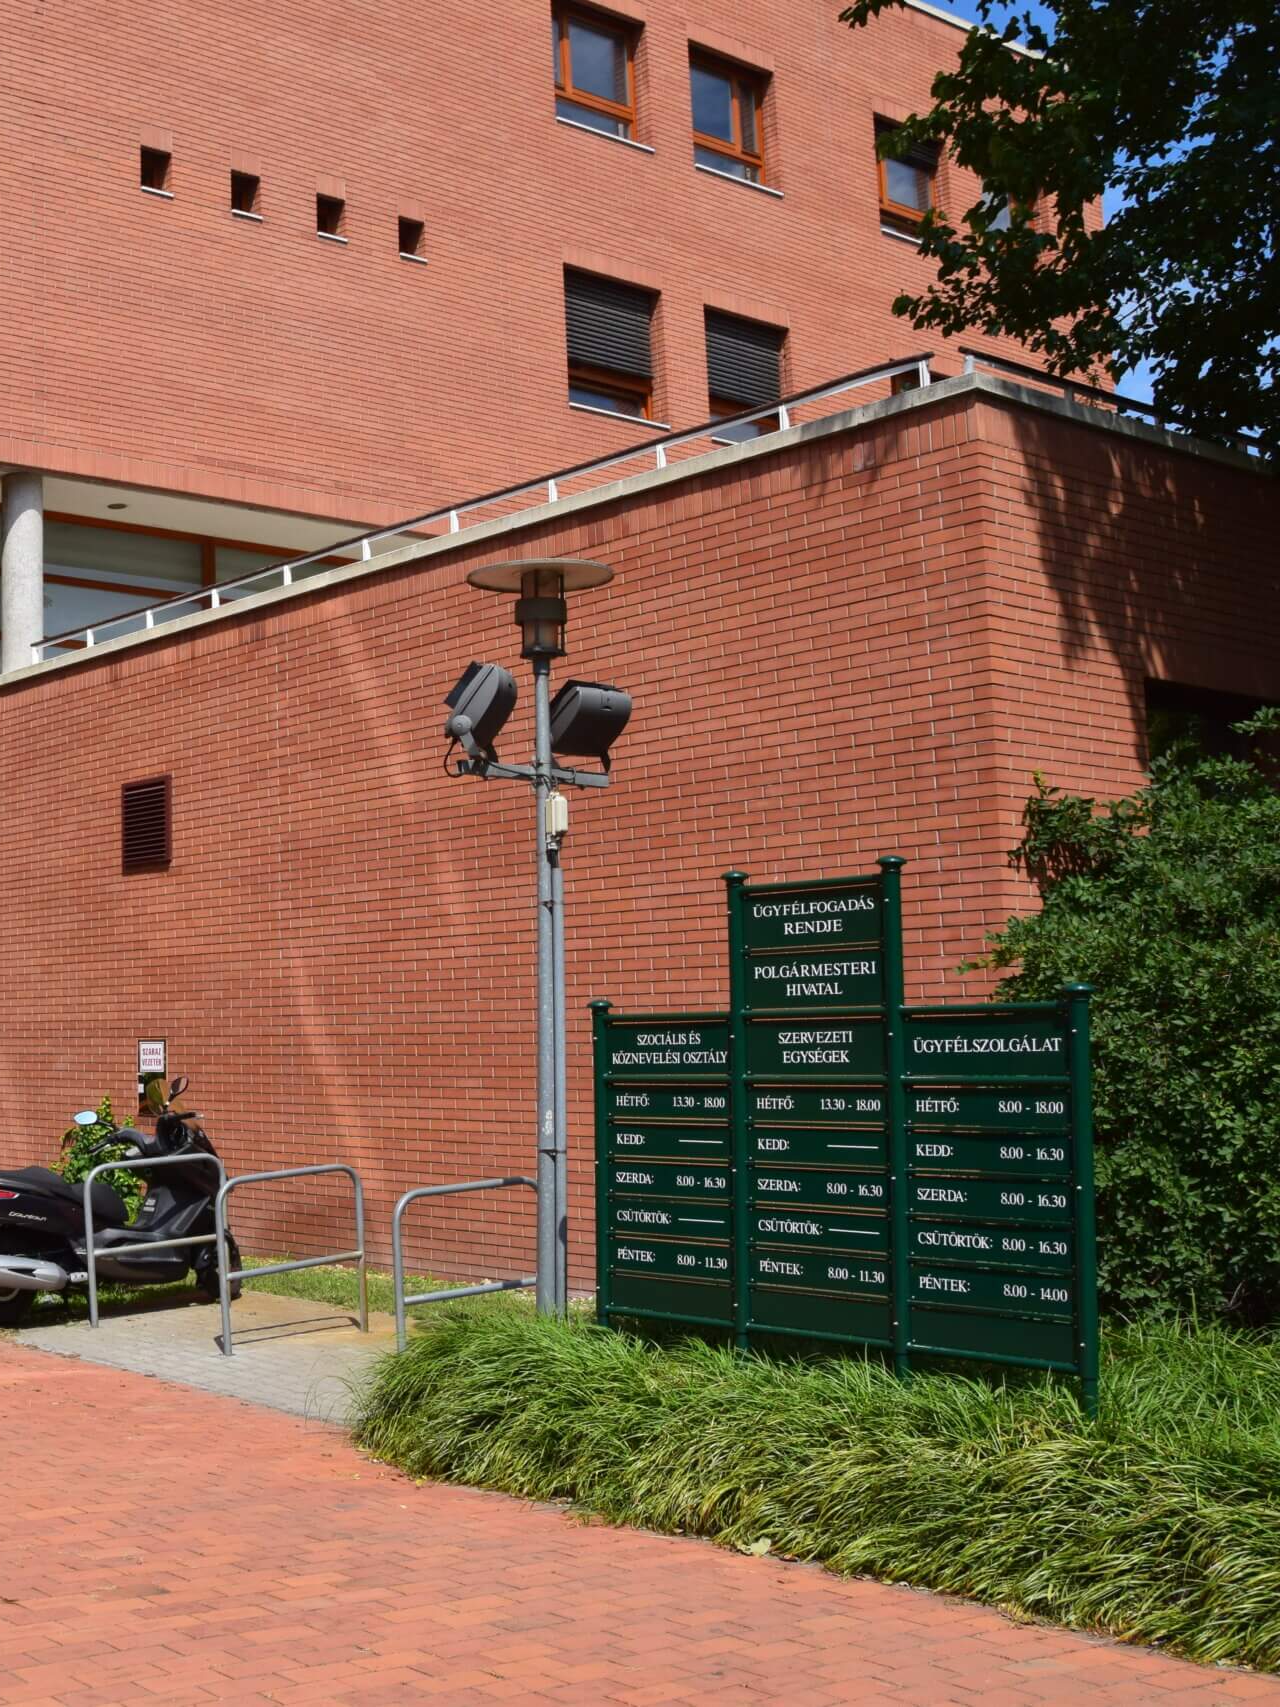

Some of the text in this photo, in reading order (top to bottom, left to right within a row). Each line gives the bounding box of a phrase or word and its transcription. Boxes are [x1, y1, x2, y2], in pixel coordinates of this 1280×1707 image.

[752, 895, 875, 917] ÜGYFÉLFOGADÁS
[783, 919, 843, 935] RENDJE
[754, 961, 876, 979] POLGÁRMESTERI
[786, 982, 843, 996] HIVATAL
[637, 1030, 701, 1046] SZOCIÁLIS ÉS
[778, 1031, 853, 1044] SZERVEZETI
[913, 1034, 1062, 1053] ÜGYFÉLSZOLGÁLAT
[612, 1048, 728, 1064] KÖZNEVELÉSI OSZTÁLY
[783, 1048, 850, 1063] EGYSÉGEK
[616, 1093, 650, 1107] HÉTFŐ:
[672, 1096, 694, 1107] 13.30
[704, 1097, 725, 1108] 18.00
[757, 1095, 794, 1110] HÉTFŐ:
[820, 1099, 845, 1110] 13.30
[856, 1099, 880, 1111] 18.00
[916, 1097, 960, 1113] HÉTFŐ:
[998, 1101, 1022, 1113] 8.00
[1035, 1102, 1063, 1114] 18.00
[616, 1133, 645, 1144] KEDD:
[757, 1138, 790, 1150] KEDD:
[916, 1144, 954, 1157] KEDD:
[1000, 1147, 1023, 1159] 8.00
[1036, 1148, 1064, 1161] 16.30
[616, 1172, 654, 1184] SZERDA:
[676, 1175, 694, 1186] 8.00
[704, 1177, 725, 1188] 16.30
[758, 1179, 801, 1192] SZERDA:
[826, 1183, 847, 1195] 8.00
[858, 1185, 882, 1197] 16.30
[917, 1188, 968, 1203] SZERDA:
[1000, 1192, 1024, 1205] 8.00
[1037, 1194, 1066, 1208] 16.30
[617, 1209, 672, 1224] CSÜTÖRTÖK:
[758, 1218, 823, 1235] CSÜTÖRTÖK:
[918, 1230, 993, 1249] CSÜTÖRTÖK:
[1002, 1238, 1025, 1251] 8.00
[1038, 1241, 1067, 1255] 16.30
[617, 1246, 655, 1263] PÉNTEK:
[677, 1254, 695, 1266] 8.00
[705, 1257, 727, 1269] 11.30
[760, 1258, 803, 1275] PÉNTEK:
[828, 1268, 848, 1280] 8.00
[859, 1270, 885, 1283] 11.30
[919, 1274, 970, 1293] PÉNTEK:
[1003, 1284, 1027, 1298] 8.00
[1040, 1288, 1068, 1302] 14.00
